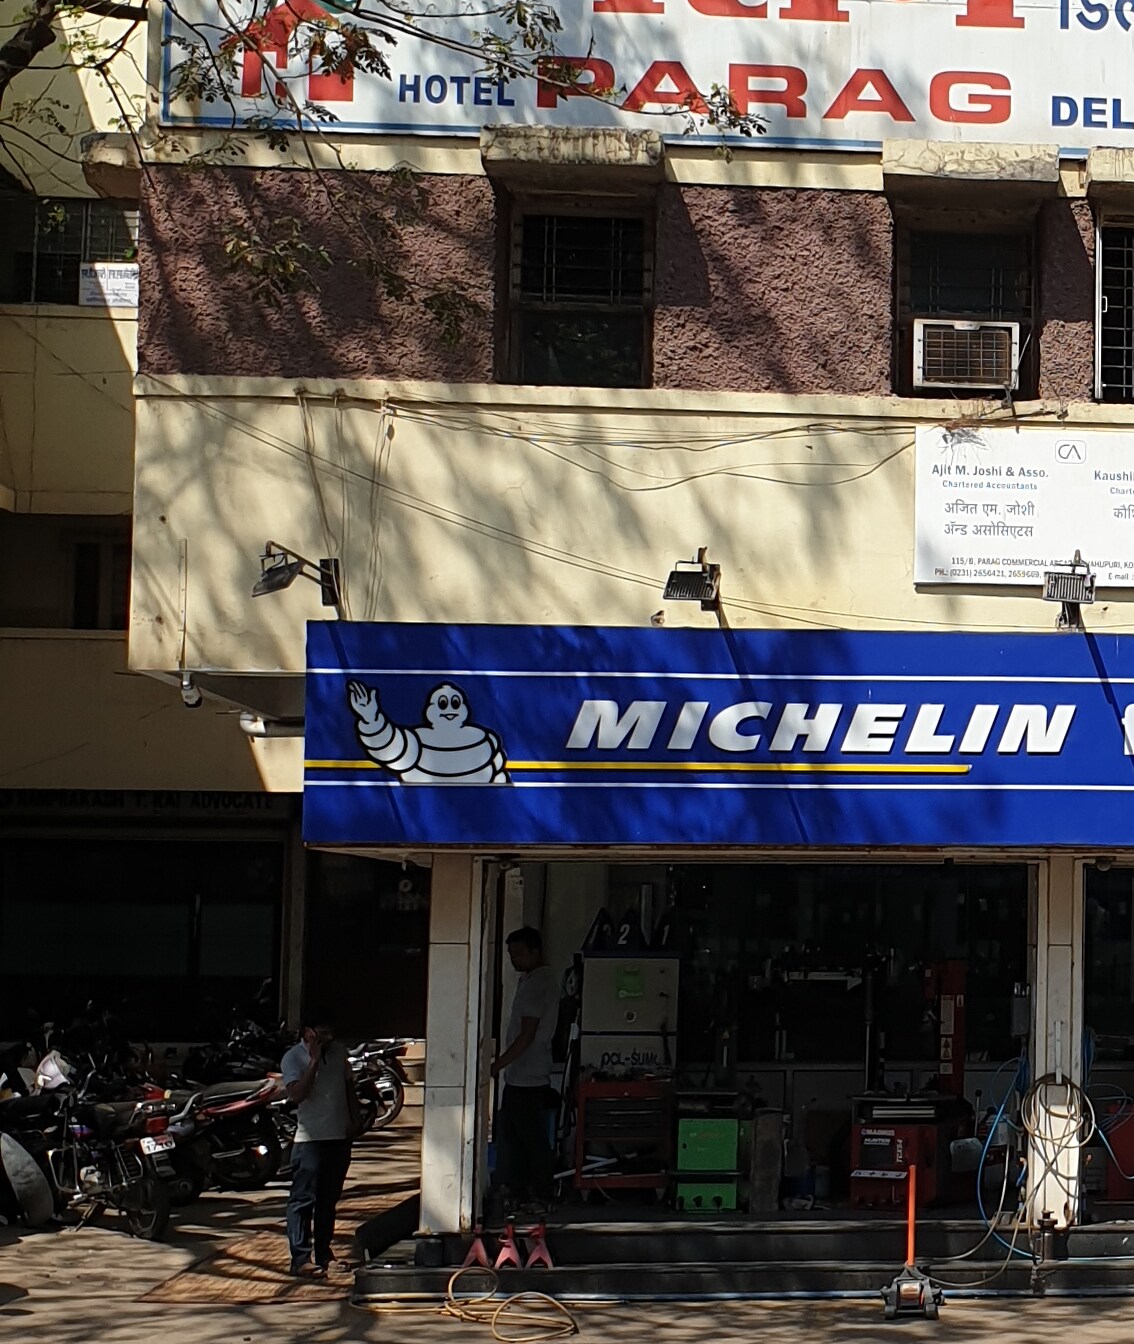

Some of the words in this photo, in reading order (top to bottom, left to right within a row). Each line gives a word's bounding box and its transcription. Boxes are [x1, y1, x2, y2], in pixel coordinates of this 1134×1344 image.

[399, 73, 516, 108] HOTEL
[535, 57, 1013, 125] PARAG
[931, 464, 952, 477] Ajit
[955, 465, 970, 476] M.
[972, 465, 1002, 477] Joshi
[1005, 466, 1015, 477] &
[1018, 467, 1049, 478] Asso.
[942, 480, 984, 488] Chartered
[986, 482, 1038, 490] Accountants
[944, 498, 978, 514] अजित
[1006, 500, 1035, 516] जोशी
[566, 699, 1077, 754] MICHELIN
